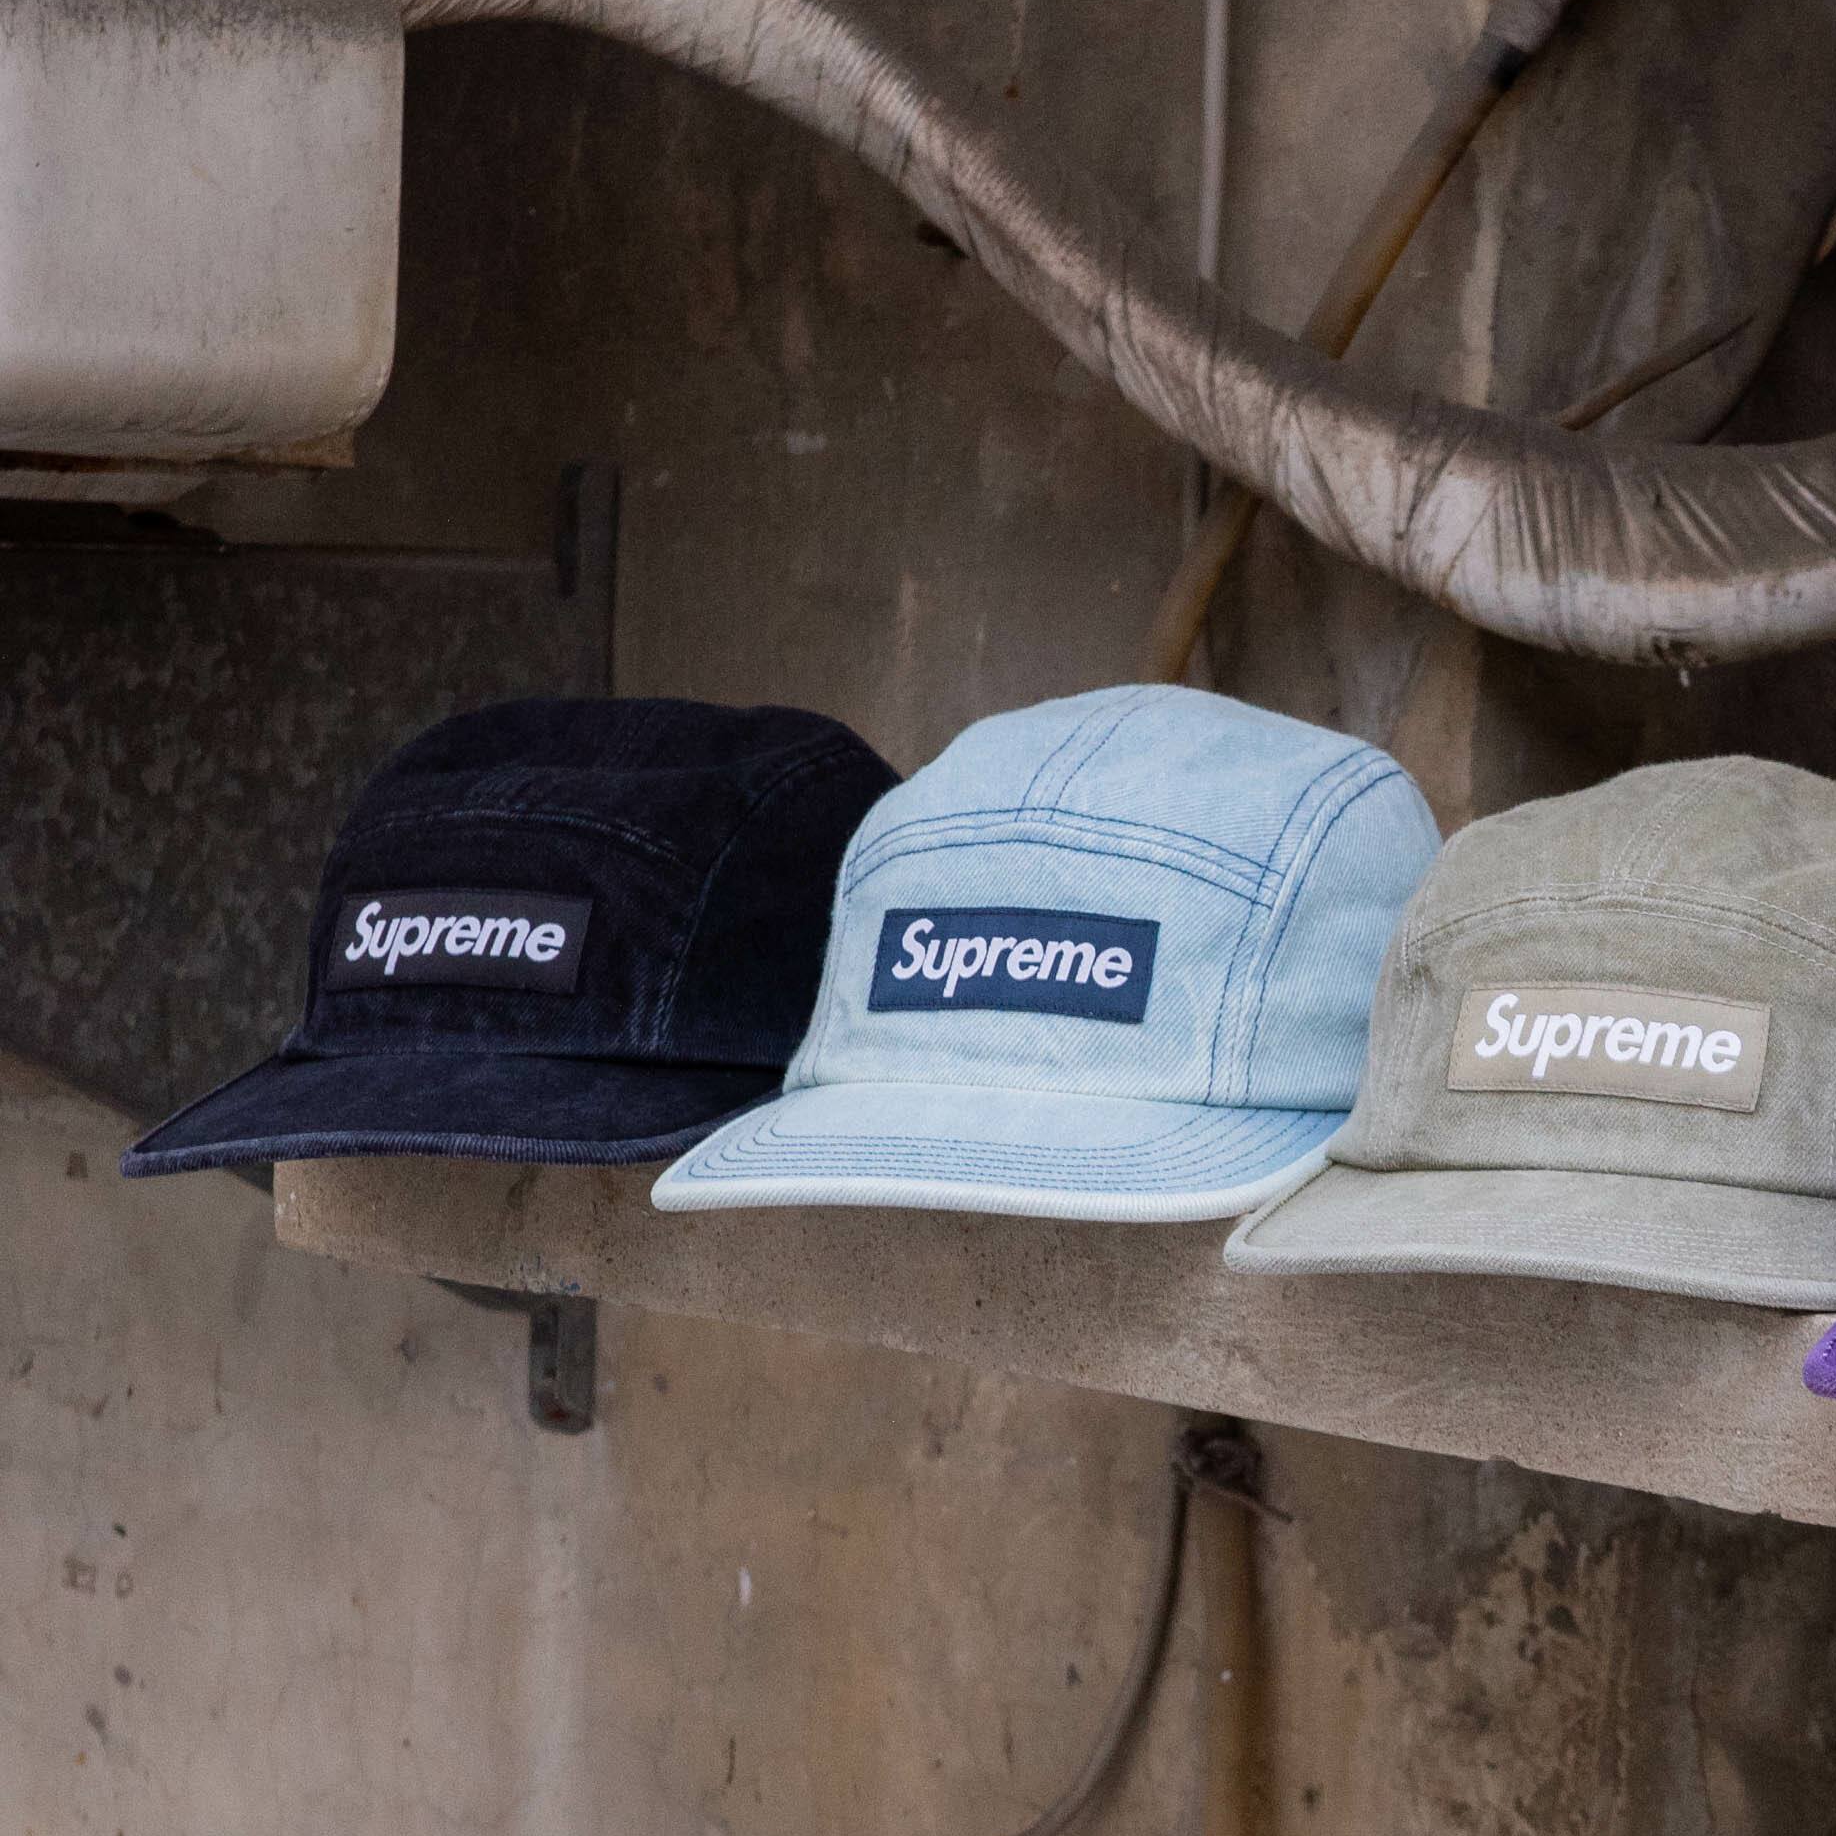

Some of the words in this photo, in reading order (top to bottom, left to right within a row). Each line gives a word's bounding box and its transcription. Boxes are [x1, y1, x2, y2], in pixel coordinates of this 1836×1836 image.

[345, 901, 566, 976] Supreme
[891, 918, 1133, 997] Supreme
[1474, 993, 1742, 1079] Supreme
